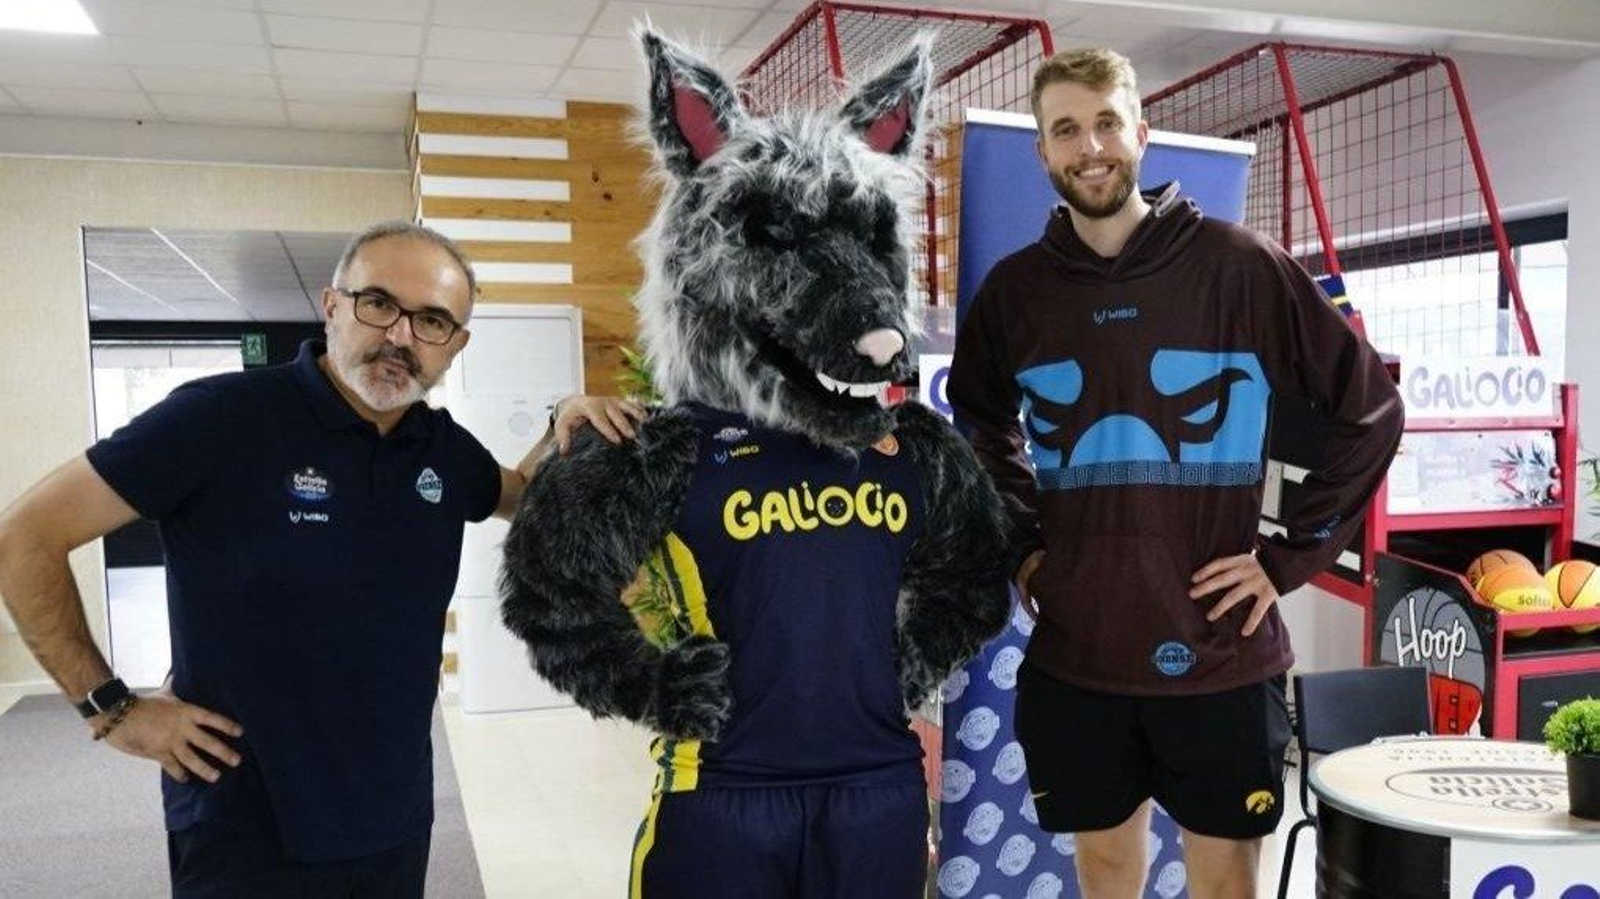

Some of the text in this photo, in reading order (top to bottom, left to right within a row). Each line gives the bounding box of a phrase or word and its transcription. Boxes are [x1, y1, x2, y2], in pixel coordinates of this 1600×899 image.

[1108, 308, 1137, 320] WIBO
[730, 445, 760, 457] WIBO
[303, 512, 329, 523] WIBO
[1394, 597, 1467, 679] Hoop
[1430, 786, 1561, 798] strella
